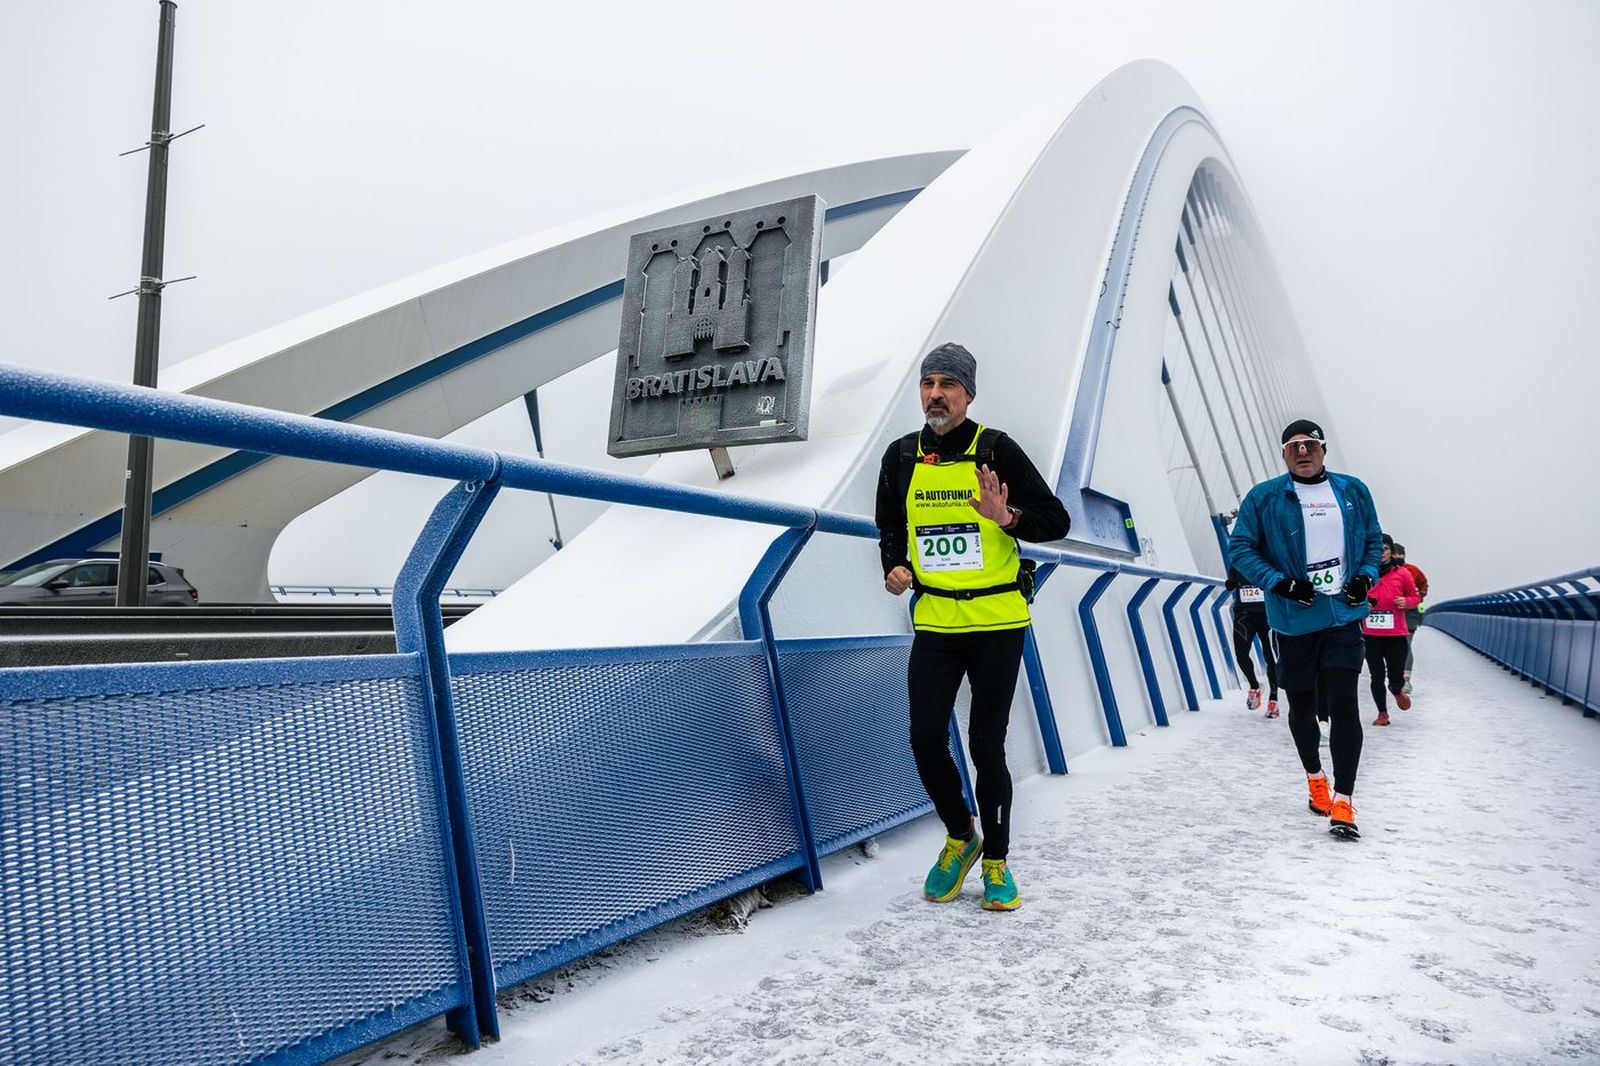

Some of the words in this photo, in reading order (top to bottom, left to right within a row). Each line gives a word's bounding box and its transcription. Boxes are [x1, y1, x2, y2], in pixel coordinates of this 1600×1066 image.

[626, 357, 785, 400] BRATISLAVA
[925, 489, 973, 500] AUTOFUNIA
[923, 536, 967, 557] 200
[1312, 570, 1334, 586] 66
[1242, 589, 1260, 597] 1124
[1370, 615, 1386, 623] 273
